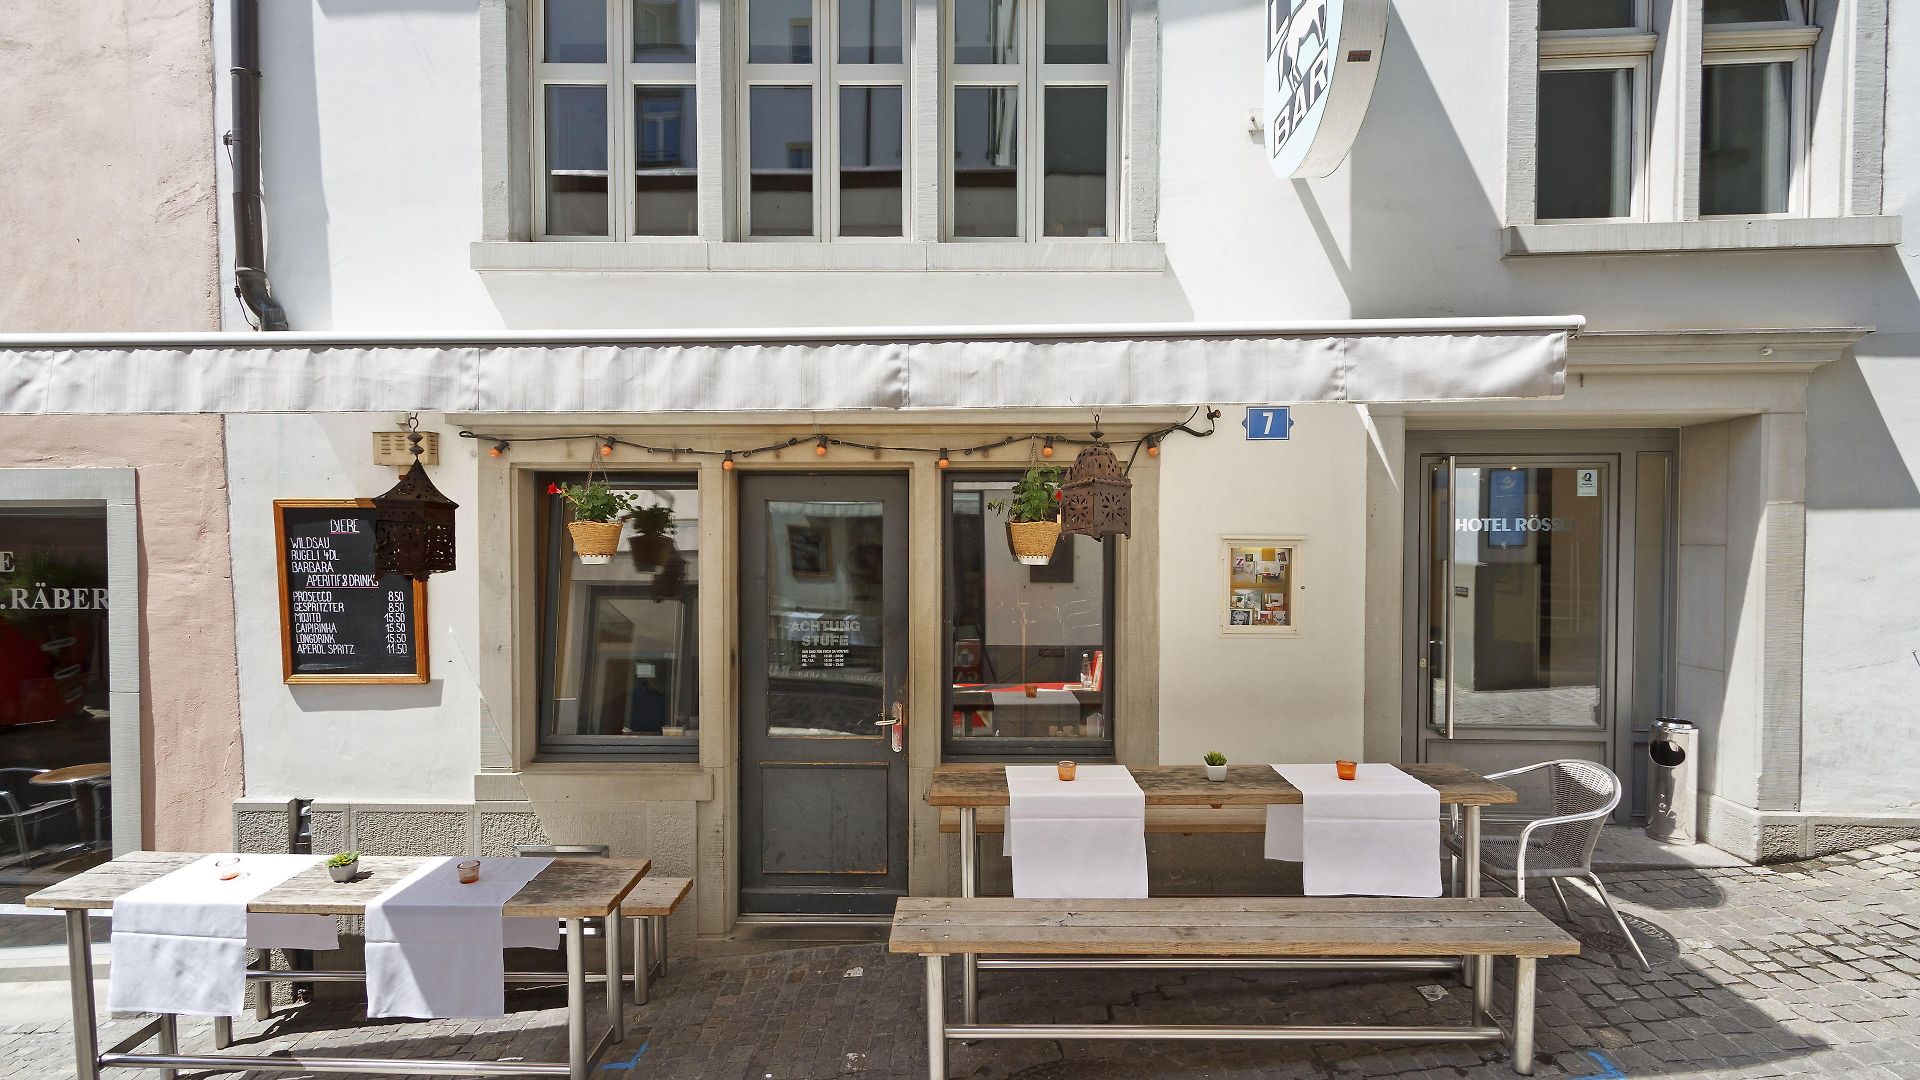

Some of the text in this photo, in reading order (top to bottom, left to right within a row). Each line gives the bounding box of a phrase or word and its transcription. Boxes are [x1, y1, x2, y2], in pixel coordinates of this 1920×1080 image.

[1274, 39, 1328, 159] BAR
[1262, 412, 1273, 435] 7
[329, 518, 359, 533] BIERE
[1455, 513, 1575, 532] HOTEL RÖSS
[290, 536, 330, 549] WILDSAU
[323, 549, 340, 560] 4DL
[291, 561, 334, 573] BARBARA
[306, 574, 341, 587] APERITIF
[292, 591, 332, 602] PROSECCO
[293, 602, 345, 613] GESPRITZTER
[294, 612, 406, 623] MOJITO 15.50
[295, 622, 406, 634] CAIPIRINHA 15.50
[790, 620, 860, 632] ACHTUNG
[295, 633, 407, 644] LONGDRINK 15.50
[801, 635, 849, 646] STUFE
[296, 643, 327, 655] APEROL
[327, 644, 356, 655] SPRITZ
